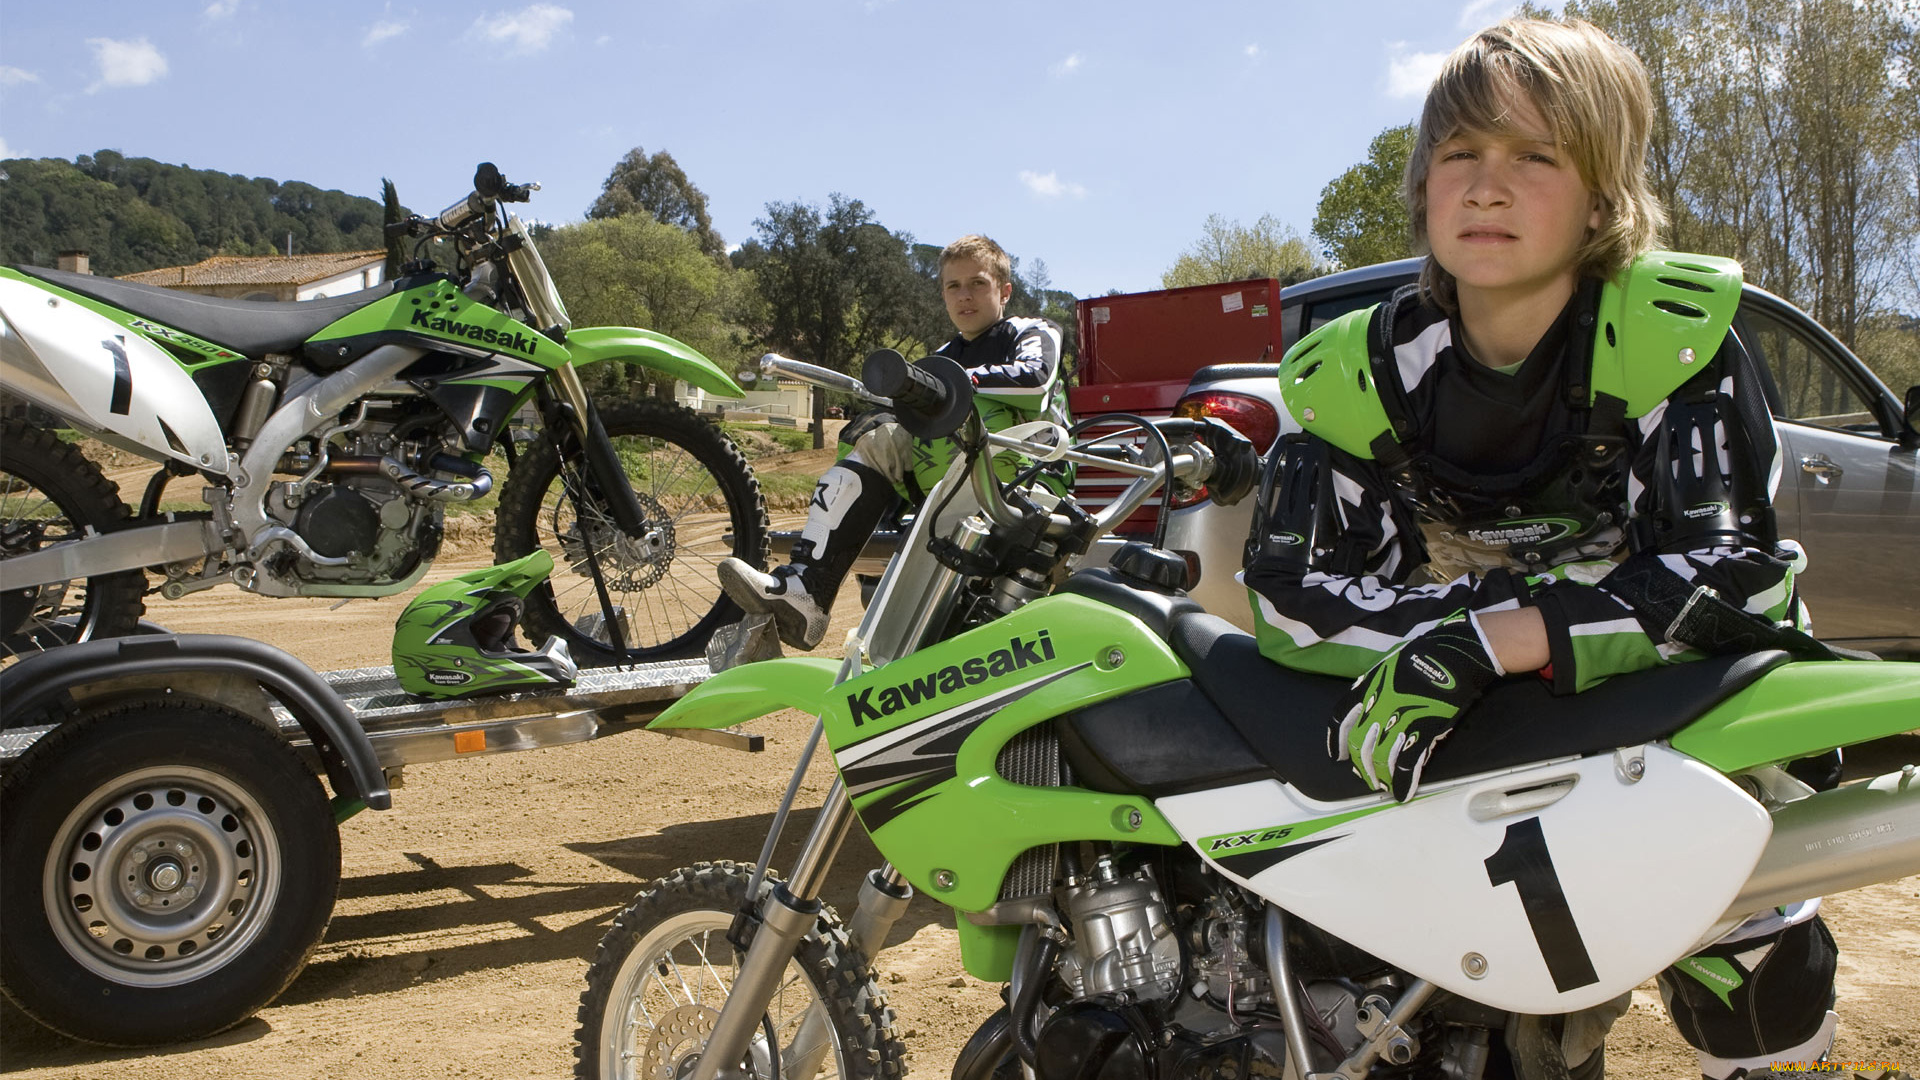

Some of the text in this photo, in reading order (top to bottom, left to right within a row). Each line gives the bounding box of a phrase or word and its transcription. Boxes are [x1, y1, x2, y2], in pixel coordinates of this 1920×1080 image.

[411, 309, 538, 355] Kawasaki
[101, 334, 132, 415] 1
[1683, 505, 1718, 516] Kawasaki
[1468, 523, 1551, 541] Kawasaki
[1484, 535, 1541, 546] Team Green
[429, 673, 464, 681] Kawasaki
[847, 629, 1056, 727] Kawasaki
[1410, 653, 1446, 681] Kawasaki
[1484, 816, 1600, 993] 1
[1689, 960, 1739, 987] Kawasaki
